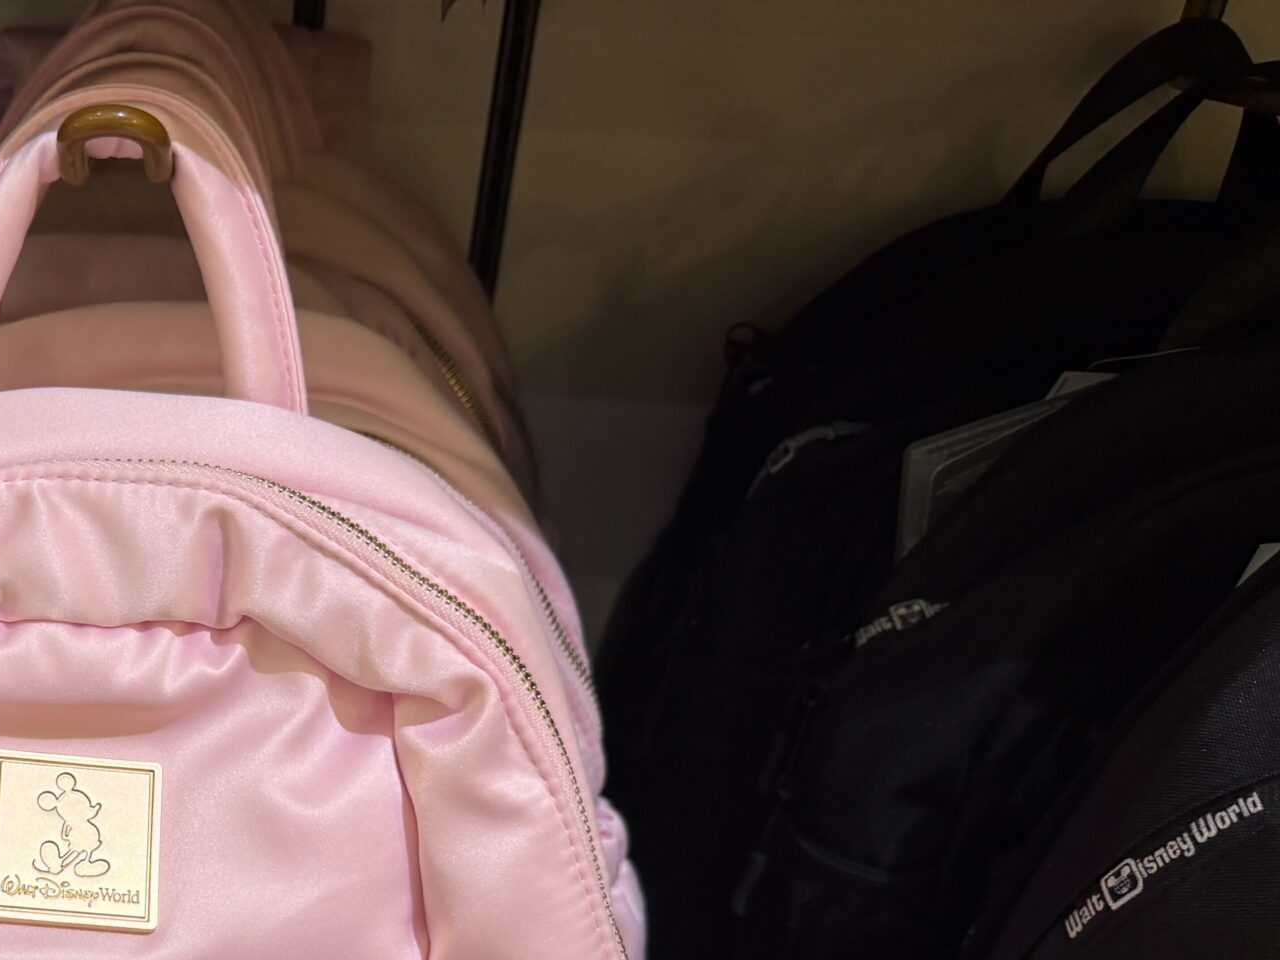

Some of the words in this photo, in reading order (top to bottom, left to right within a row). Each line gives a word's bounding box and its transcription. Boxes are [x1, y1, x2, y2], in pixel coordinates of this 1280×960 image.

[98, 886, 141, 905] World
[1064, 892, 1105, 938] Walt
[1100, 832, 1196, 911] Disney
[1190, 791, 1265, 844] World
